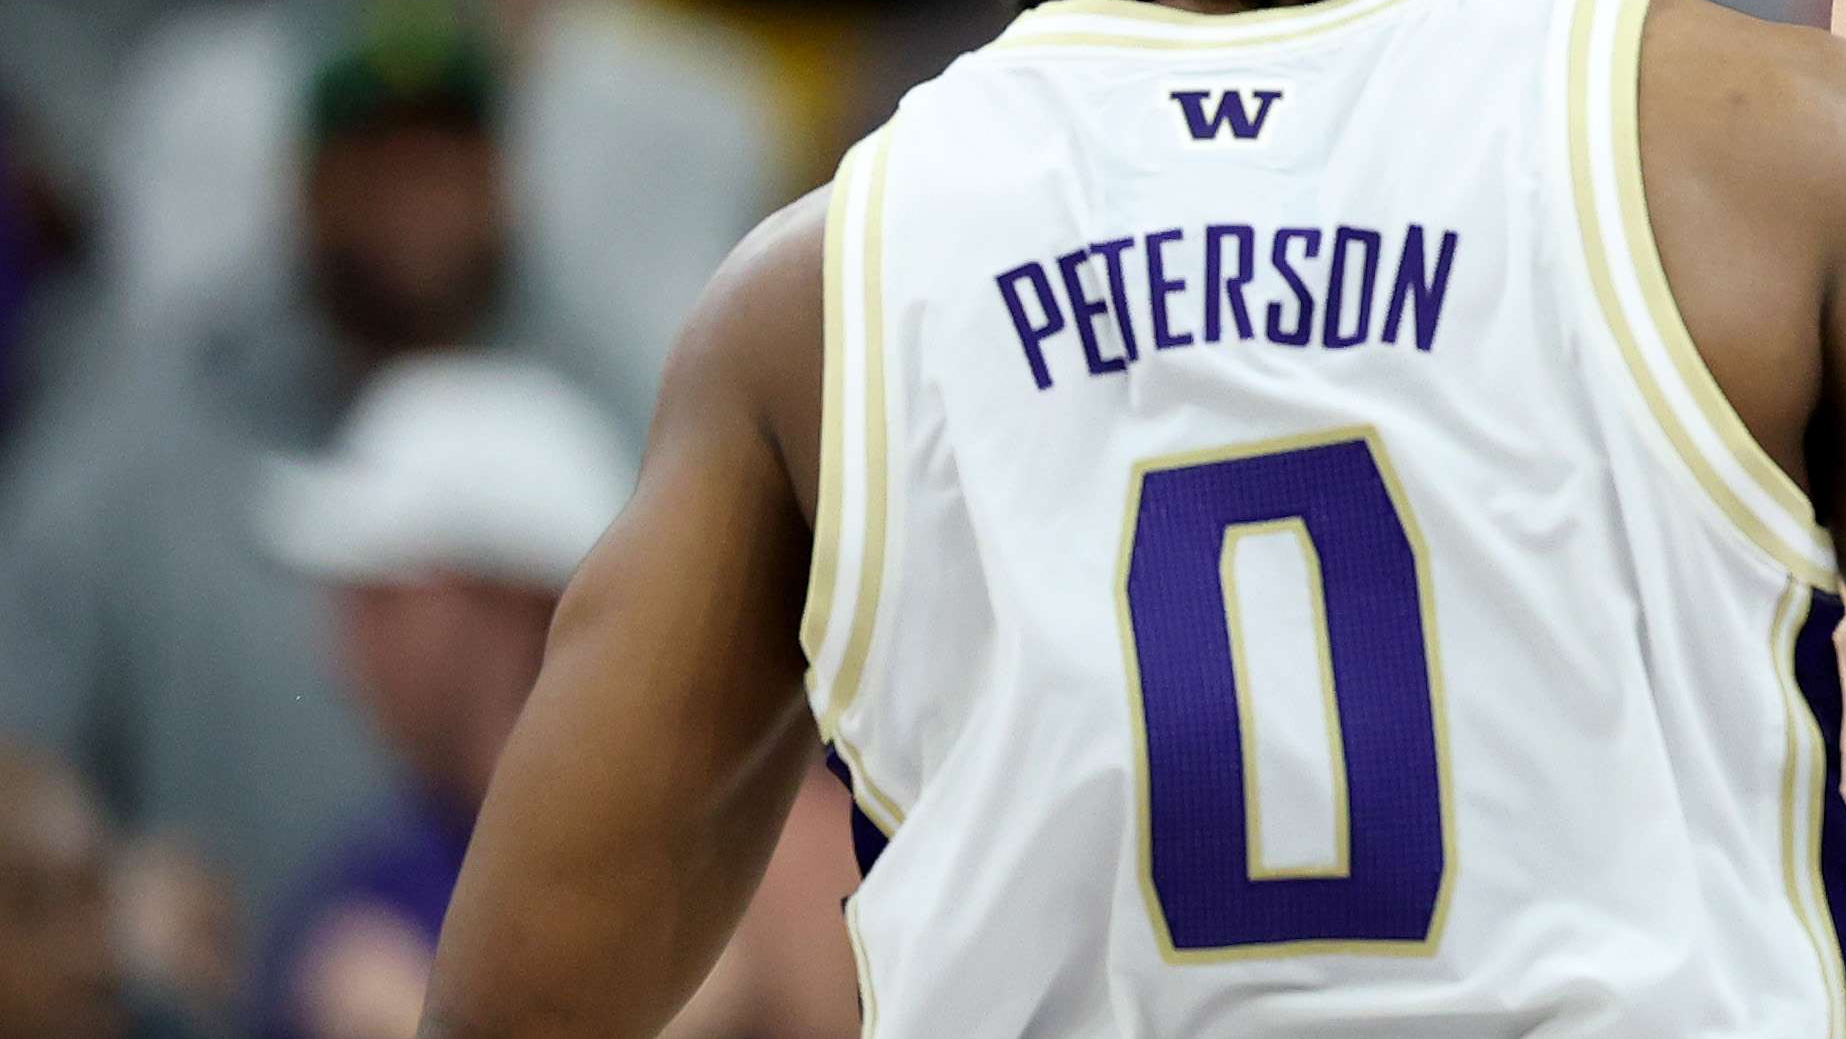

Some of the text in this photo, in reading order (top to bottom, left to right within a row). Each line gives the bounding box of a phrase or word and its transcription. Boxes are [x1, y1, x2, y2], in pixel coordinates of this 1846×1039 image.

[1170, 89, 1283, 141] W
[995, 223, 1459, 391] PETERSON
[1113, 423, 1458, 966] 0
